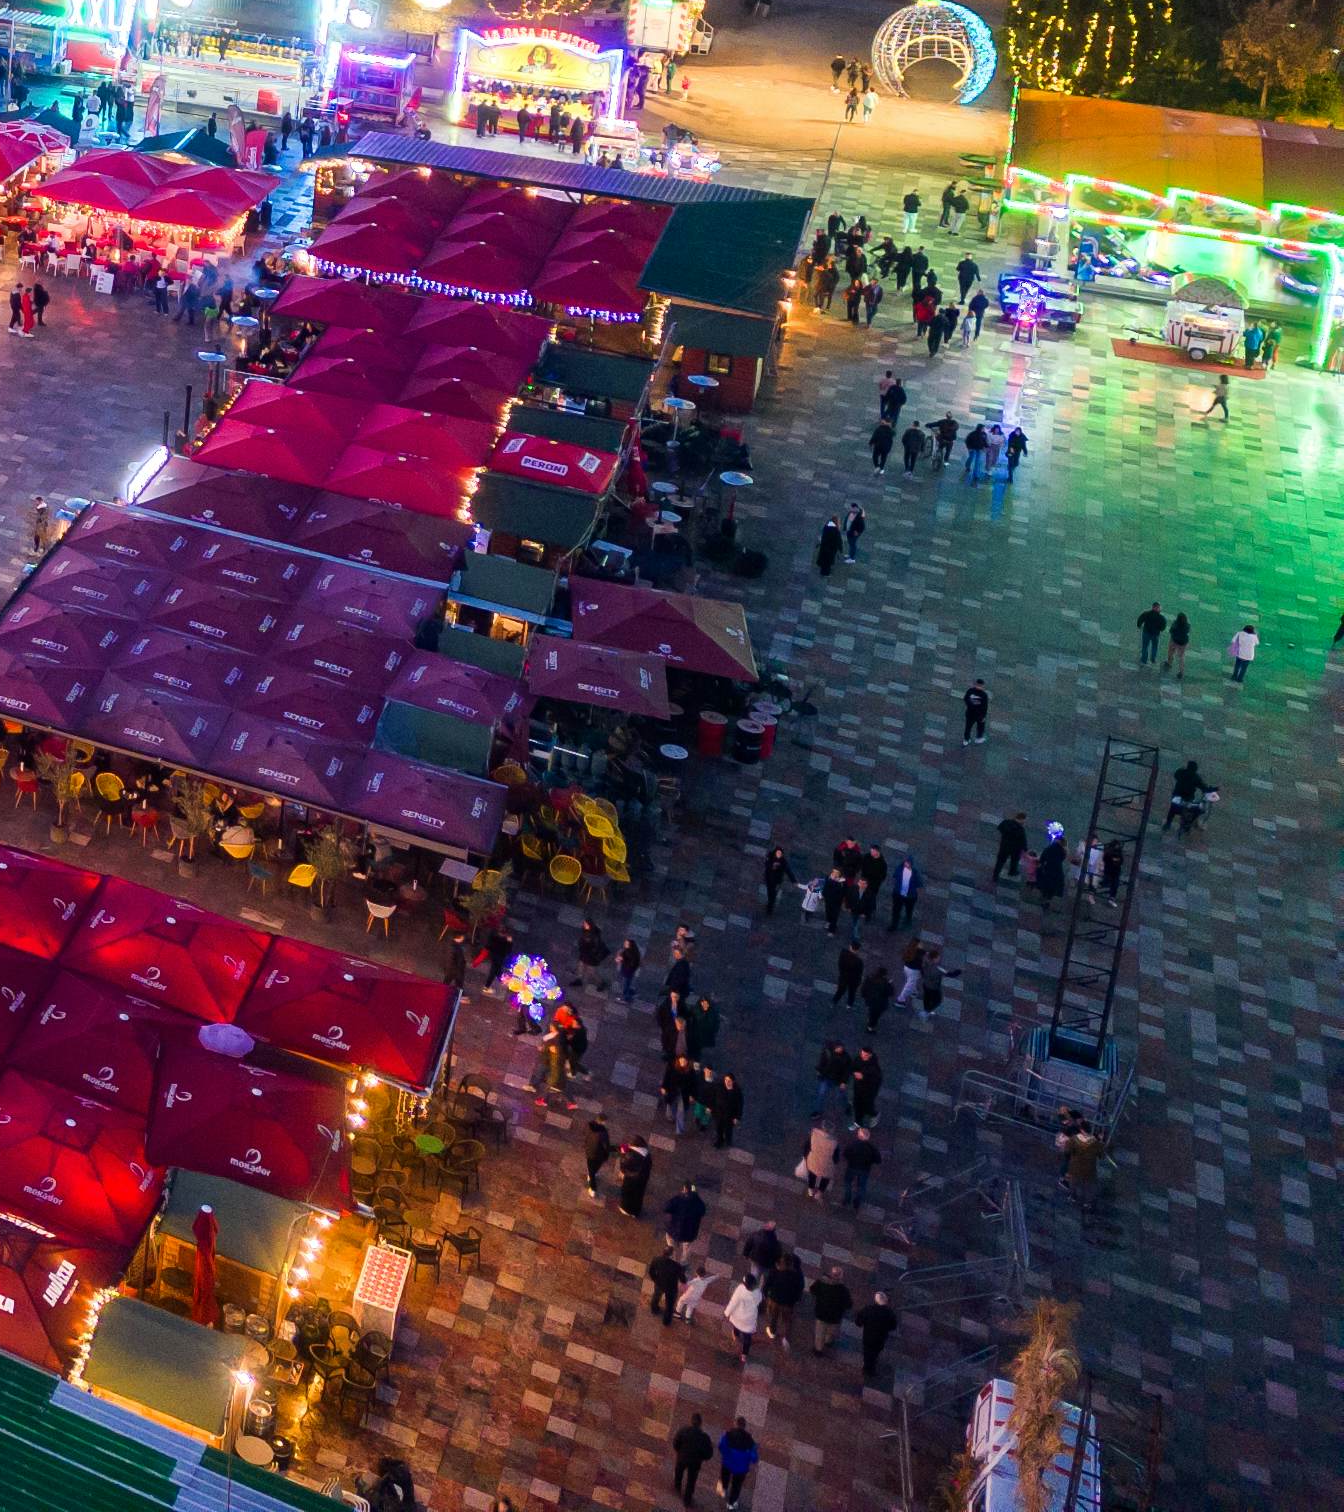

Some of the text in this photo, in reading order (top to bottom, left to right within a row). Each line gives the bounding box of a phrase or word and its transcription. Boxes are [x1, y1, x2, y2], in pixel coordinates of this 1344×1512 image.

[523, 457, 567, 475] PERONI
[577, 683, 620, 697] SENSITY
[437, 698, 478, 716] SENSITY
[124, 728, 164, 744] SENSITY
[258, 768, 300, 783] SENSITY
[401, 809, 445, 828] SENSITY
[43, 1260, 76, 1307] LAVAZZA
